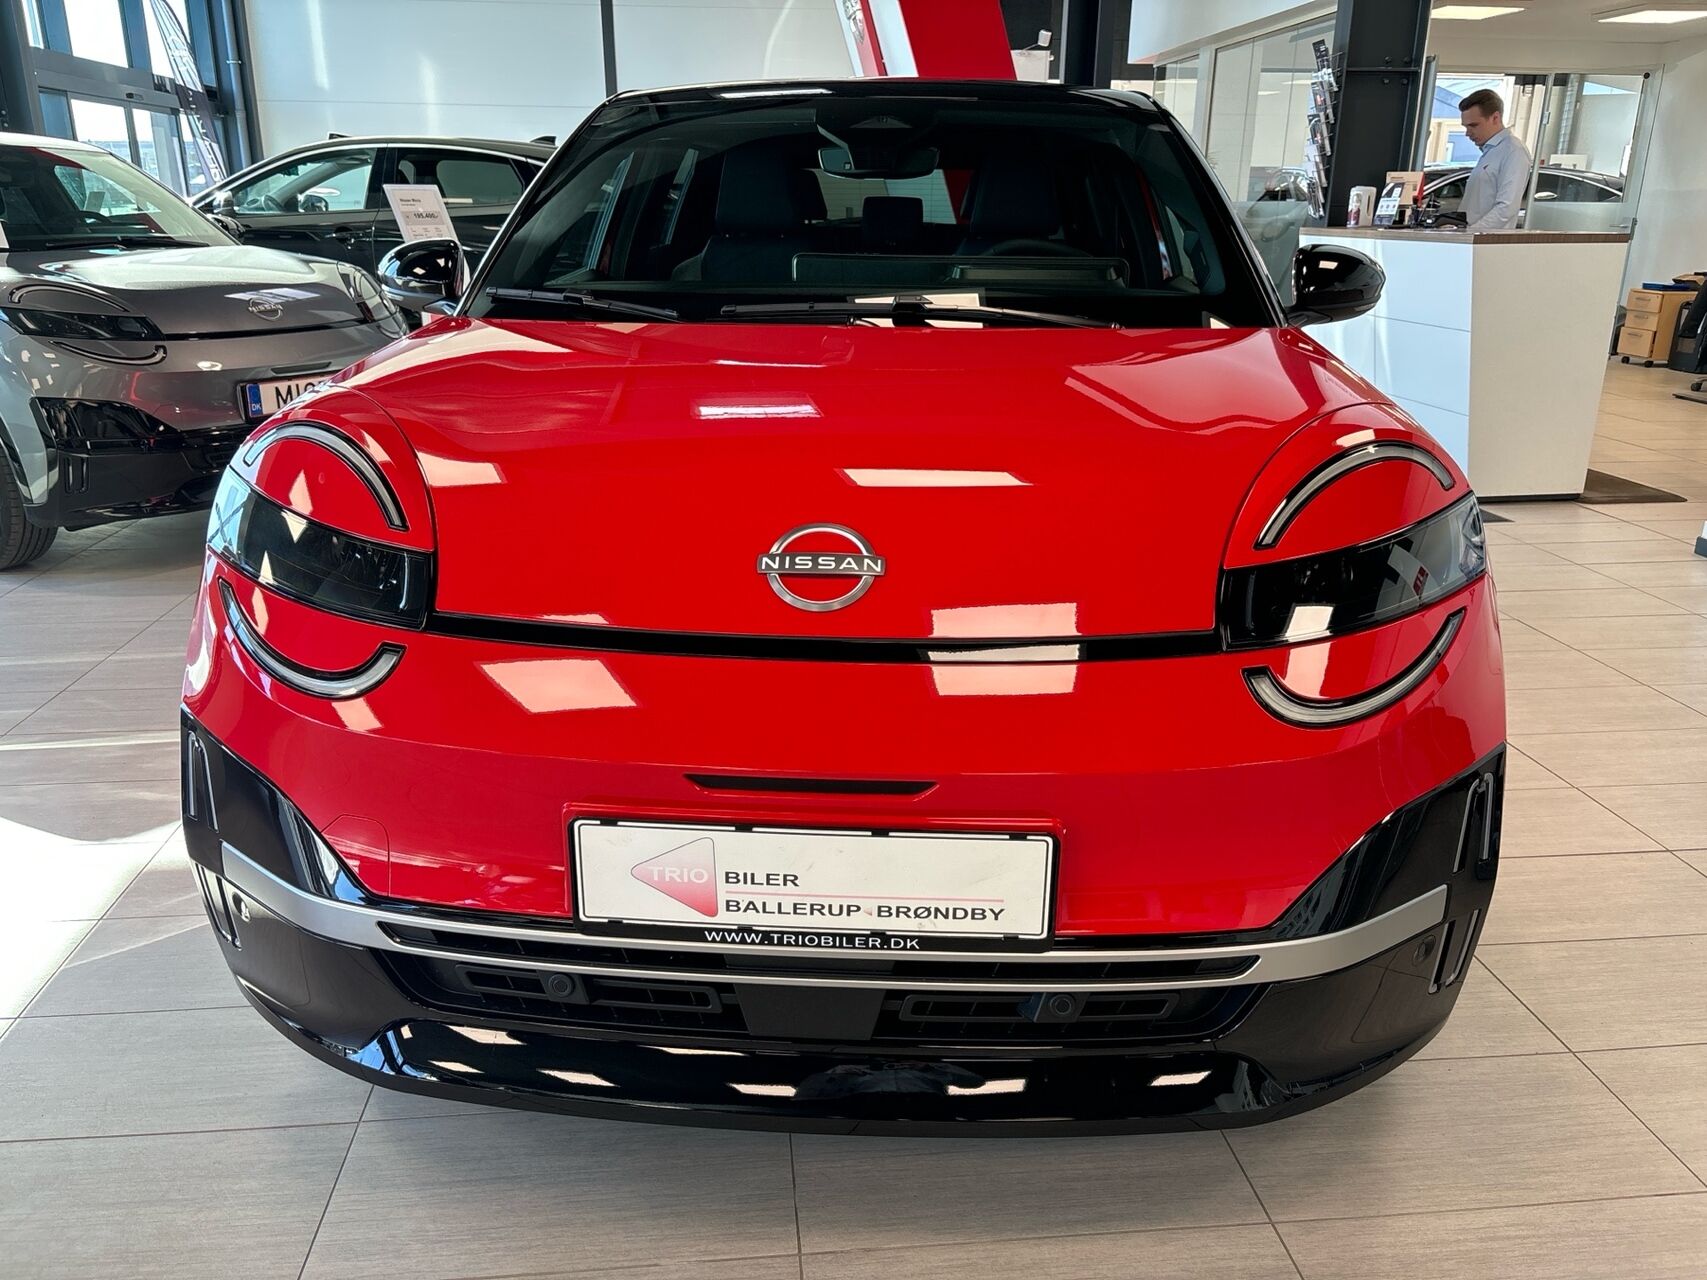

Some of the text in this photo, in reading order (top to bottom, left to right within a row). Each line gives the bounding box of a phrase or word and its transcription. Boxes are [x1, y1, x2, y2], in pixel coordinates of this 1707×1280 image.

[761, 556, 882, 572] NISSAN
[649, 866, 800, 887] TRIO BILER
[725, 899, 1006, 921] BALLERUP BRØNDBY
[704, 930, 920, 950] WWW.TRIOBILER.DK
